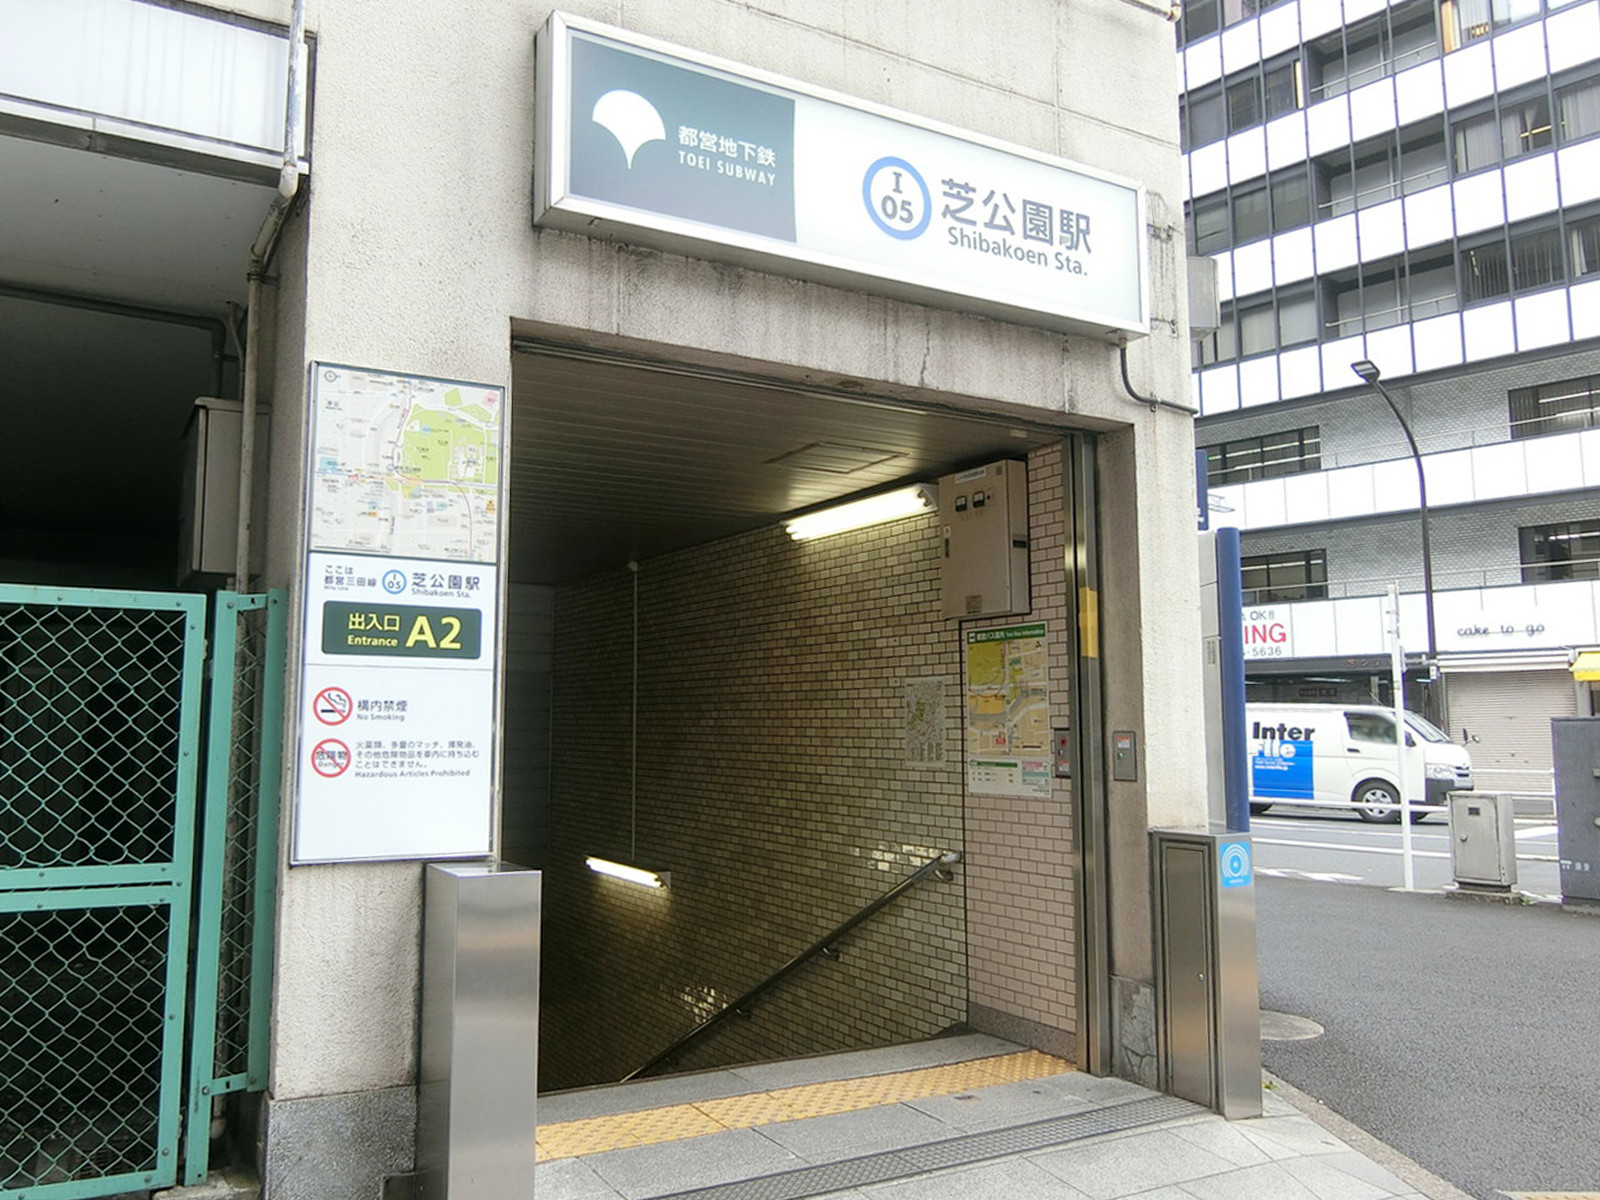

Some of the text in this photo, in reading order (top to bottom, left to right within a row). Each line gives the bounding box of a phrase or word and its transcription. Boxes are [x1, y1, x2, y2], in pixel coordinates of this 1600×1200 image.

[678, 125, 776, 167] 都営地下鉄
[678, 150, 776, 186] TOEI SUBWAY
[893, 171, 903, 194] I
[881, 195, 914, 224] 05
[940, 177, 1092, 254] 芝公園駅
[947, 226, 1088, 277] Shibakoen Sta.
[325, 564, 354, 575] ここは
[324, 575, 377, 587] 都営三田線
[387, 580, 401, 590] 05
[411, 572, 480, 591] 芝公園駅
[411, 587, 455, 598] Shibakoen
[348, 612, 400, 632] 出入口
[1457, 623, 1545, 638] cake to go
[347, 634, 399, 648] Entrance
[405, 615, 462, 650] A2
[1244, 622, 1287, 645] ING
[358, 700, 408, 712] 構内禁煙
[357, 713, 405, 722] No Smoking
[1253, 722, 1315, 741] Inter
[355, 769, 471, 779] Hazardous Articles Prohibited
